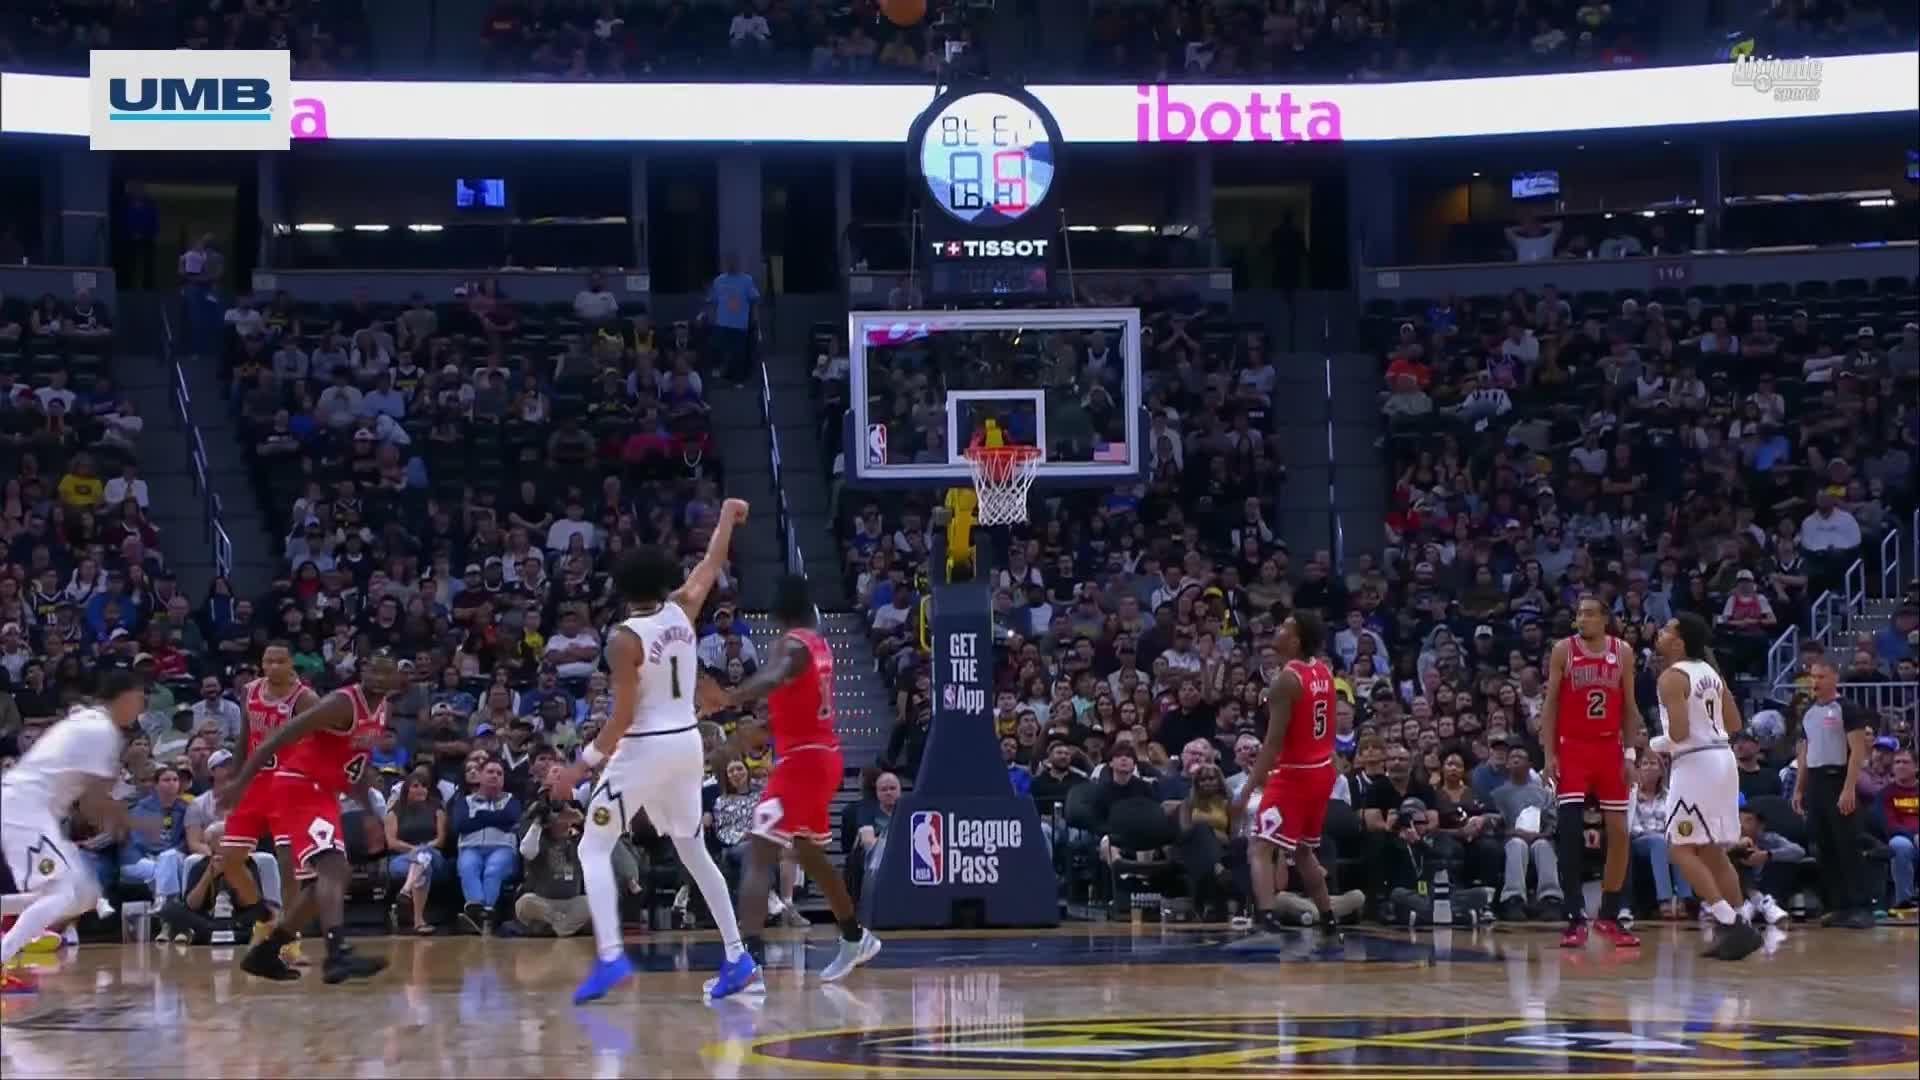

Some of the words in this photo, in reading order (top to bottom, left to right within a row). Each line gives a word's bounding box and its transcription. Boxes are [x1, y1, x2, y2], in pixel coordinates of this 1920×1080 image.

[1136, 84, 1344, 143] ibotta
[963, 239, 1048, 257] TISSOT
[949, 633, 977, 657] GET
[669, 655, 681, 699] 1
[949, 658, 978, 682] THE
[956, 684, 985, 715] App
[1586, 689, 1607, 720] 2
[1312, 699, 1328, 740] 5
[343, 752, 368, 784] 4
[948, 812, 1022, 854] League
[948, 848, 999, 884] Pass
